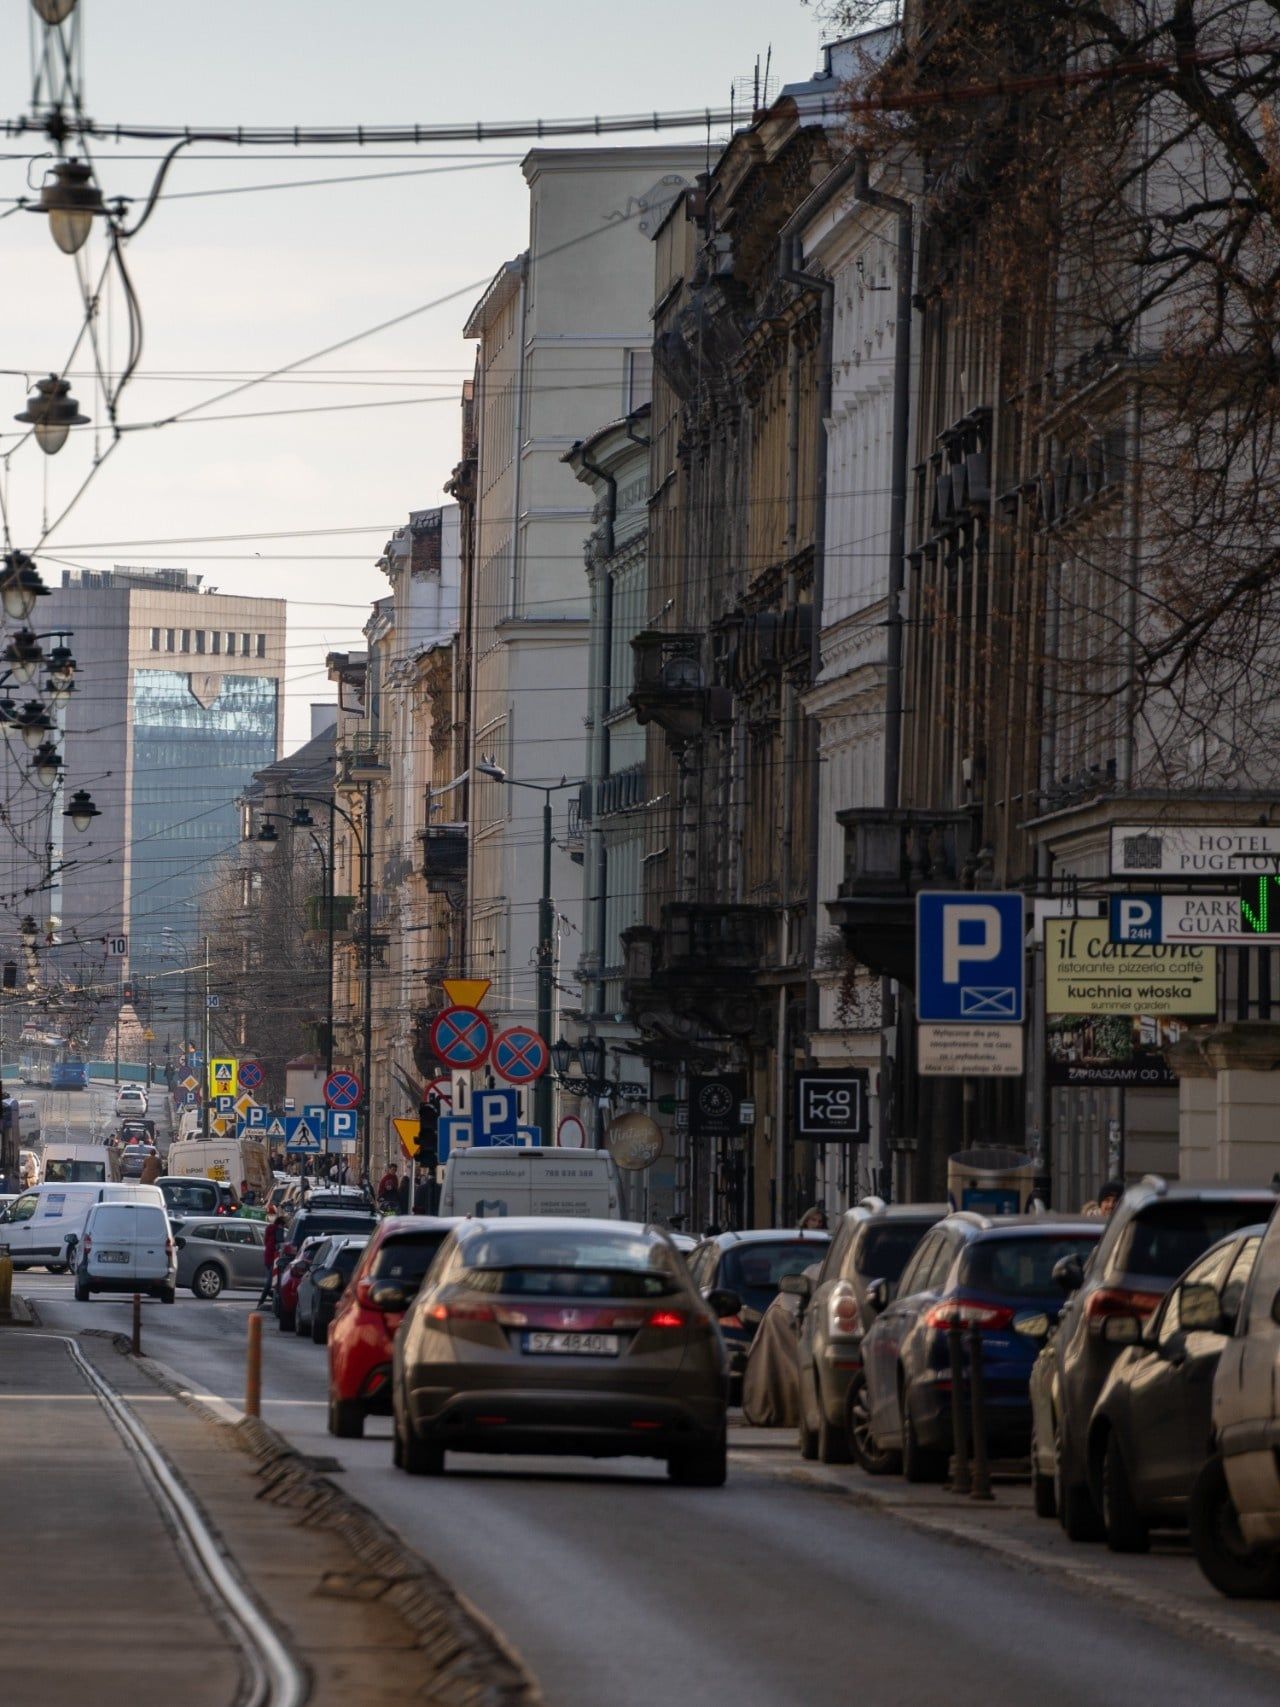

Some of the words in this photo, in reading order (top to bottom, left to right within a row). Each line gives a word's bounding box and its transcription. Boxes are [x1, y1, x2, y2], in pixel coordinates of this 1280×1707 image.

[1199, 835, 1272, 851] HOTEL
[1185, 900, 1239, 916] PARK
[1121, 900, 1152, 939] P
[1130, 928, 1152, 939] 24H
[110, 939, 125, 953] 10
[943, 904, 1001, 984] P
[1058, 962, 1115, 973] ristorante
[1118, 962, 1165, 975] pizzeria
[1068, 985, 1132, 998] kuchnia
[1138, 985, 1192, 998] włoska
[1091, 1002, 1131, 1010] summer
[1134, 1001, 1170, 1011] garden
[1069, 1068, 1138, 1079] ZAPRASZAMY
[1141, 1069, 1158, 1079] OD
[220, 1097, 231, 1111] P
[250, 1108, 264, 1126] P
[482, 1095, 508, 1135] P
[333, 1113, 351, 1136] P
